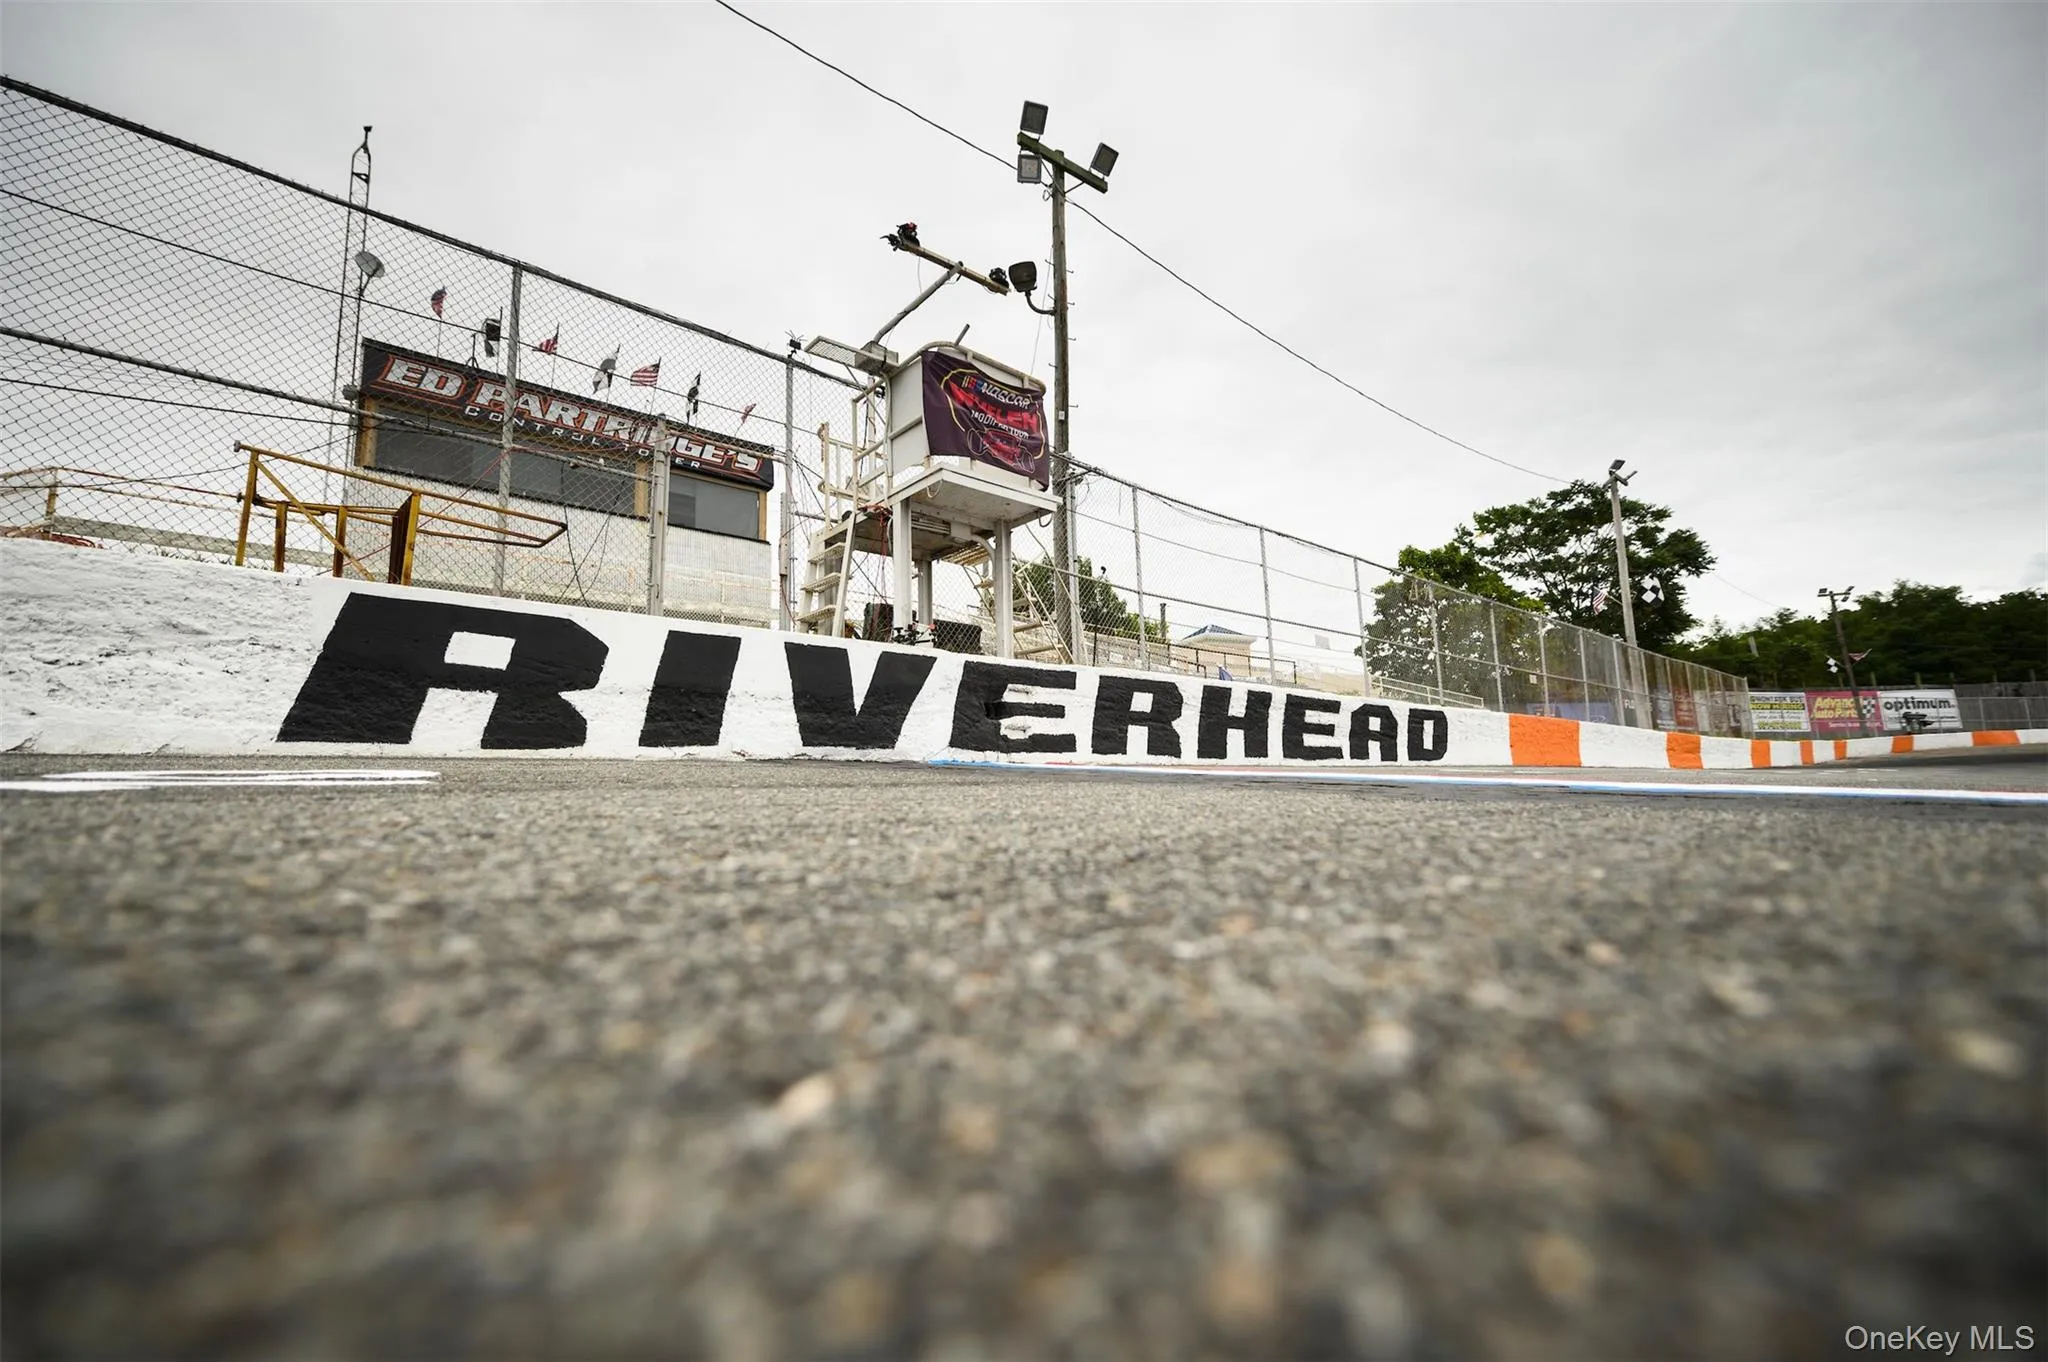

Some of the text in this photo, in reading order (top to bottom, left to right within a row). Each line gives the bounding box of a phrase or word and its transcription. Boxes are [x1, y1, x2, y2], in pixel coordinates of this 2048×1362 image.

[383, 357, 465, 398] ED
[981, 382, 1031, 409] NASCAR
[464, 405, 701, 469] CONTROL TOER
[275, 591, 1449, 762] RIVERHEAD
[1814, 697, 1857, 709] Advanc
